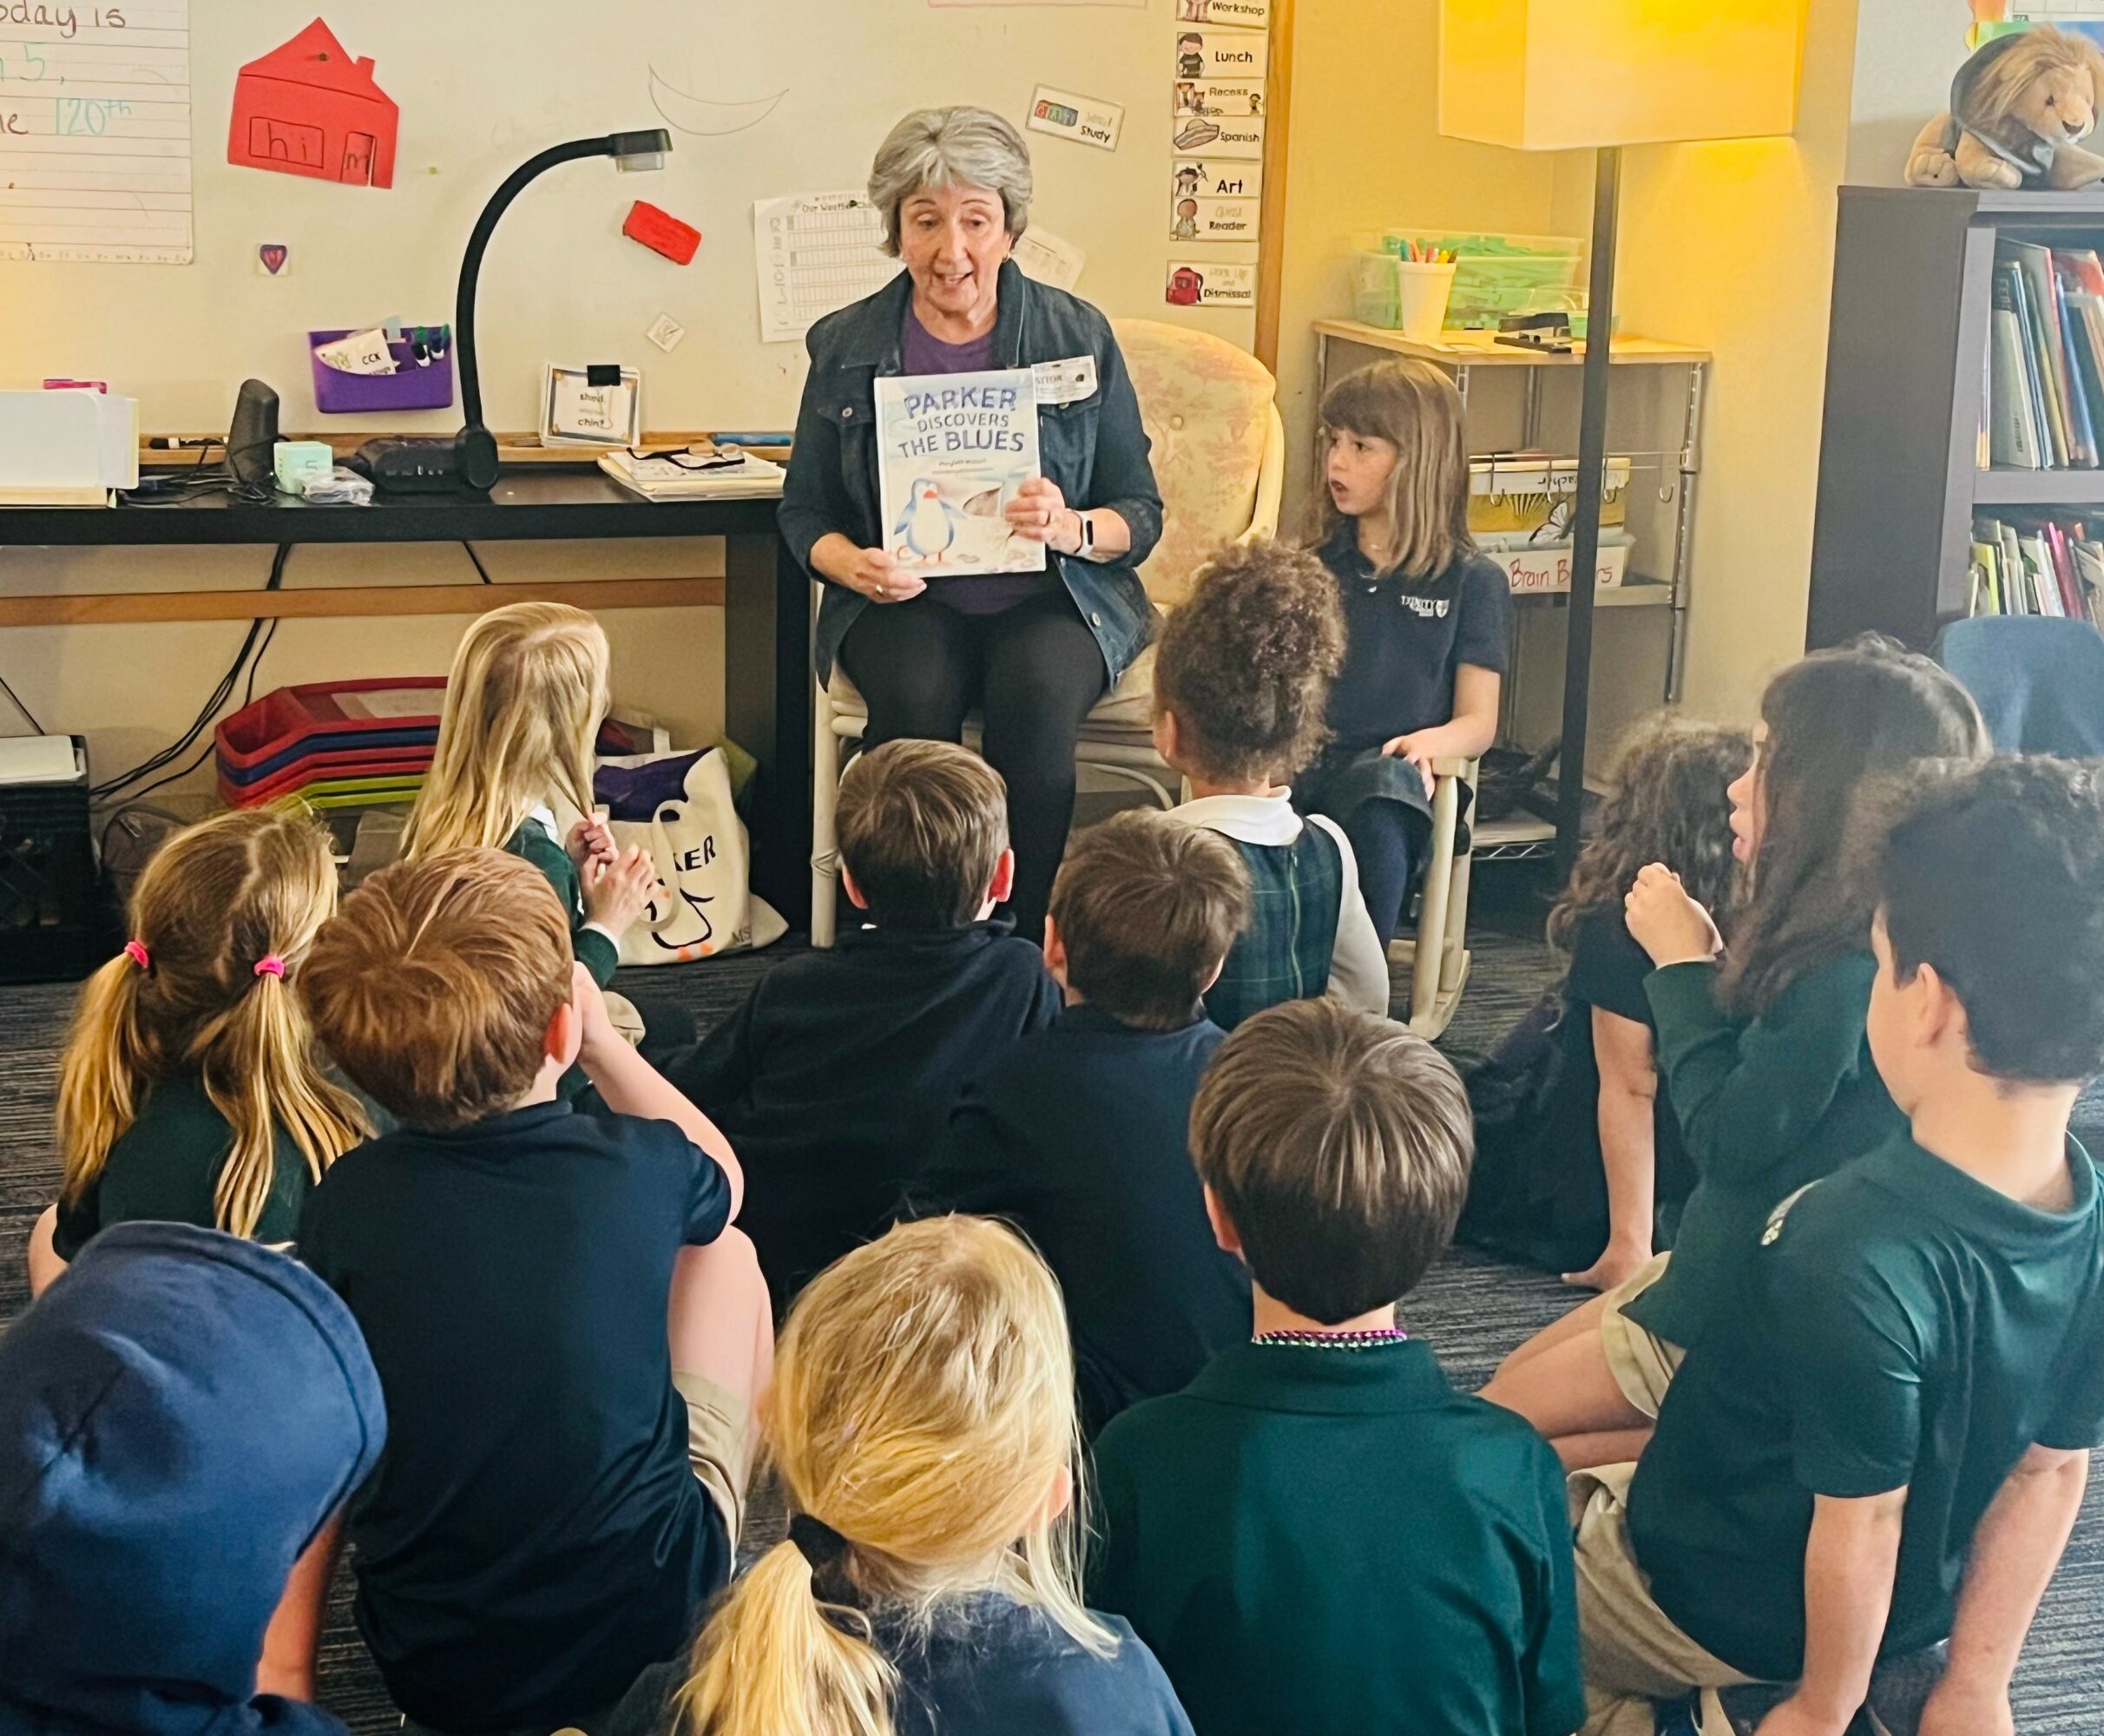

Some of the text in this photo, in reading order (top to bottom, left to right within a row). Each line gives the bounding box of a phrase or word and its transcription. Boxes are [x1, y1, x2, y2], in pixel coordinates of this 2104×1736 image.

[1212, 2, 1265, 16] Workshop
[95, 7, 127, 28] is
[1215, 51, 1252, 62] Lunch
[1209, 87, 1248, 96] Recess
[267, 122, 307, 161] hi
[1081, 125, 1111, 143] Study
[1220, 132, 1259, 142] Spanish
[1216, 180, 1243, 194] Art
[1209, 220, 1247, 230] Reader
[1204, 288, 1251, 299] Dismissal
[904, 386, 1017, 419] PARKER
[917, 413, 1009, 432] DISCOVERS
[897, 429, 1025, 458] THE BLUES
[1509, 558, 1549, 588] Brain
